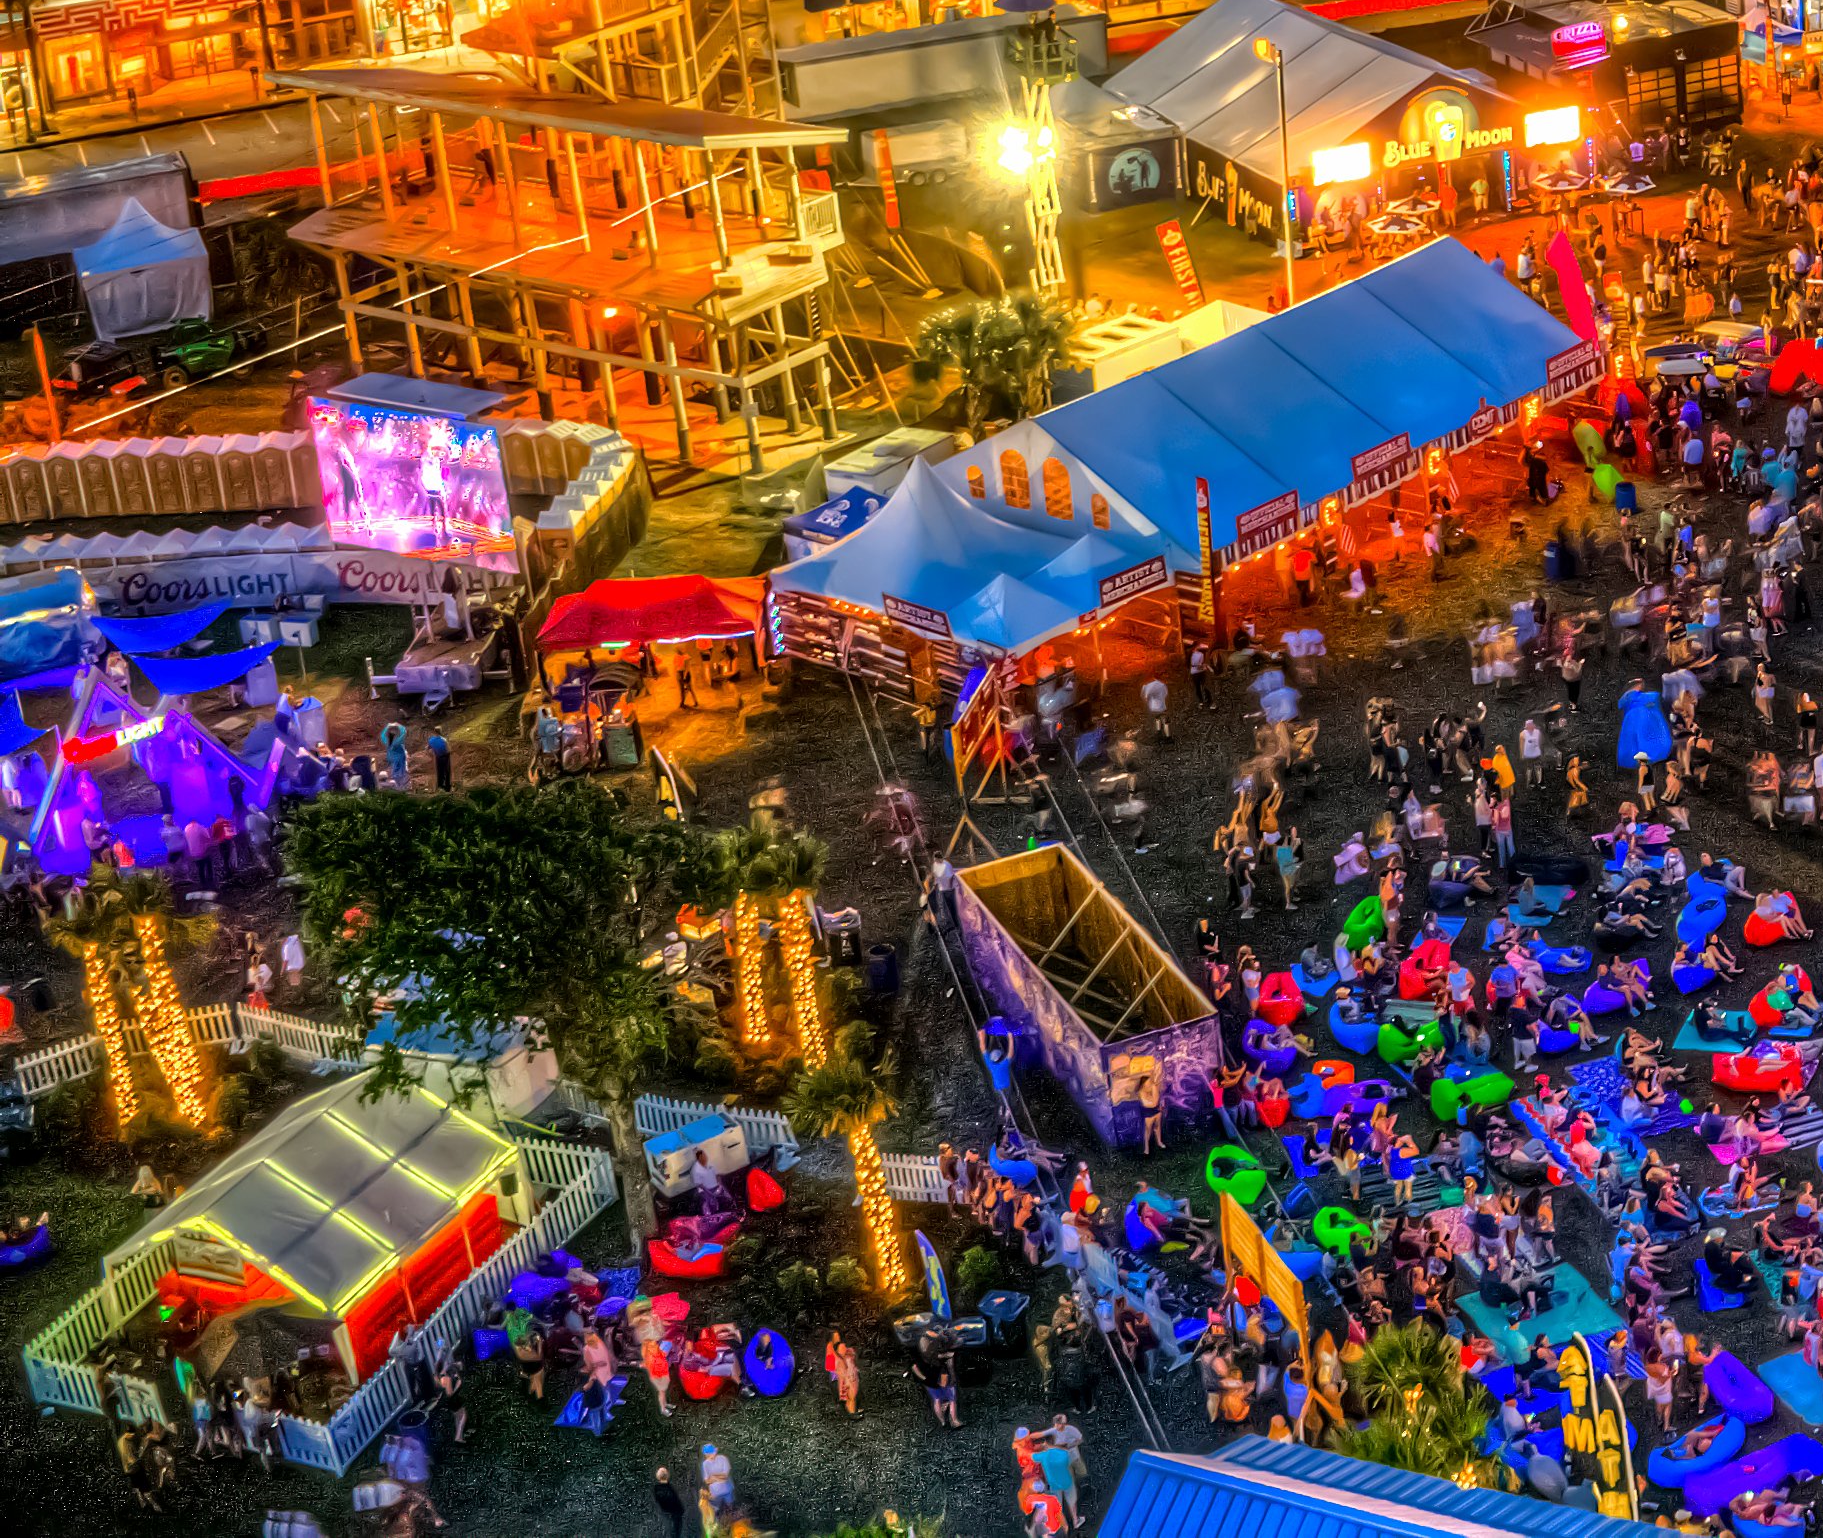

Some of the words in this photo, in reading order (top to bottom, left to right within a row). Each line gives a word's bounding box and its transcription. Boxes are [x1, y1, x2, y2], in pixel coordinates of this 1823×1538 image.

[1384, 141, 1431, 167] BLUE
[1465, 127, 1513, 149] MOON
[1168, 247, 1196, 288] FIRST
[118, 573, 214, 606] Coors
[213, 573, 290, 597] LIGHT
[337, 560, 426, 594] Coors
[116, 716, 164, 745] LIGHT
